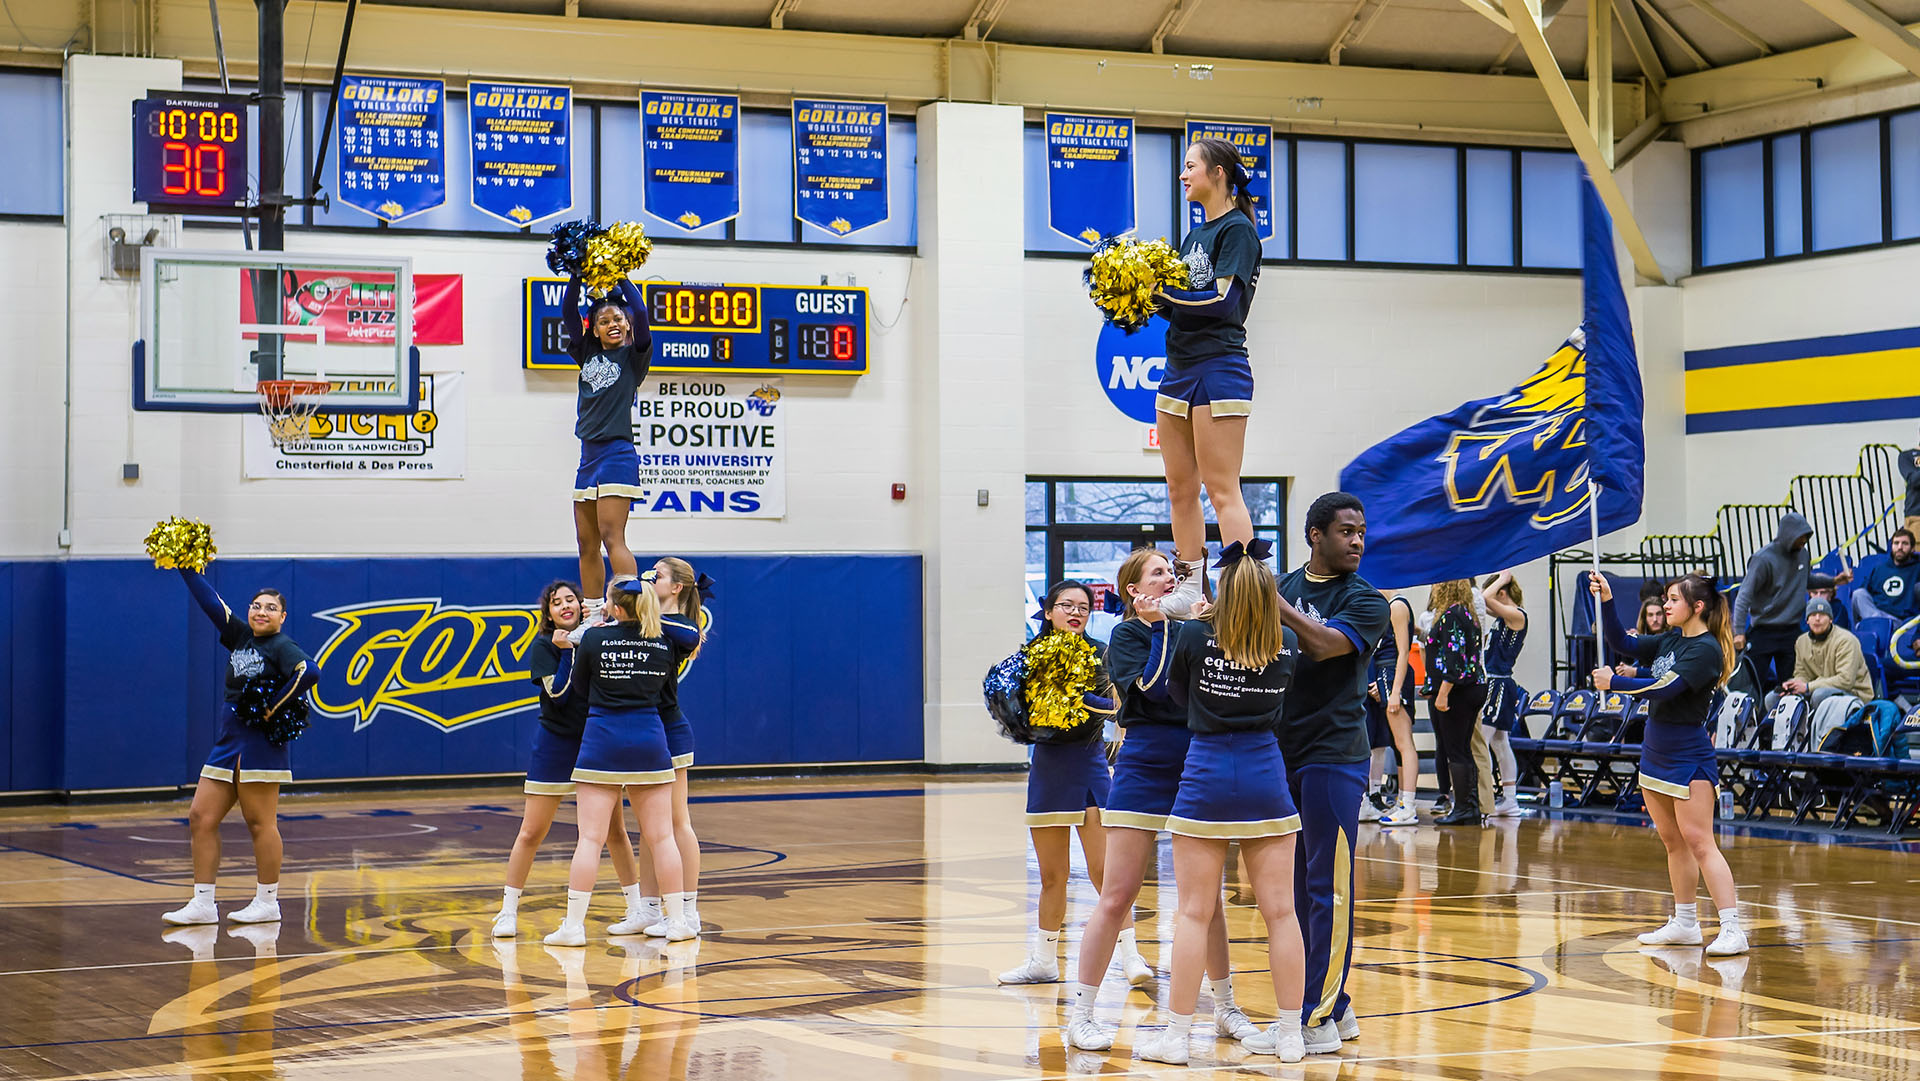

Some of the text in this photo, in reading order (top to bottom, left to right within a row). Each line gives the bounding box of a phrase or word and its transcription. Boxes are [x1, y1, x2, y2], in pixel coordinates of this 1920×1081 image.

[344, 85, 438, 103] GORLOKS
[166, 100, 219, 108] DAKTRONICS
[354, 101, 428, 112] WOMENS SOCCER
[475, 92, 565, 110] GORLOKS
[499, 108, 540, 118] SOFTBALL
[646, 101, 733, 118] GORLOKS
[360, 119, 422, 127] CHAMPIONSHIPS
[378, 113, 426, 121] CONFERENCE
[662, 116, 717, 126] MENS TENNIS
[799, 109, 881, 125] GORLOKS
[508, 120, 554, 128] CONFERENCE
[808, 124, 872, 134] WOMENS TENNIS
[1051, 123, 1128, 138] GORLOKS
[1051, 136, 1078, 145] WOMENS
[368, 164, 414, 172] CHAMPIONS
[378, 158, 428, 166] TOURNAMENT
[507, 163, 556, 171] TOURNAMENT
[164, 142, 224, 196] 30
[666, 290, 752, 325] 10:00
[796, 292, 857, 314] GUEST
[348, 310, 415, 324] PIZZ
[662, 339, 730, 359] PERIOD 1
[1108, 356, 1167, 390] NC
[659, 383, 726, 396] BE LOUD
[640, 401, 744, 418] BE PROUD
[632, 424, 774, 447] E POSITIVE
[276, 460, 433, 470] Chesterfield & Des Peres
[638, 455, 773, 467] STER UNIVERSITY
[1887, 580, 1900, 592] P
